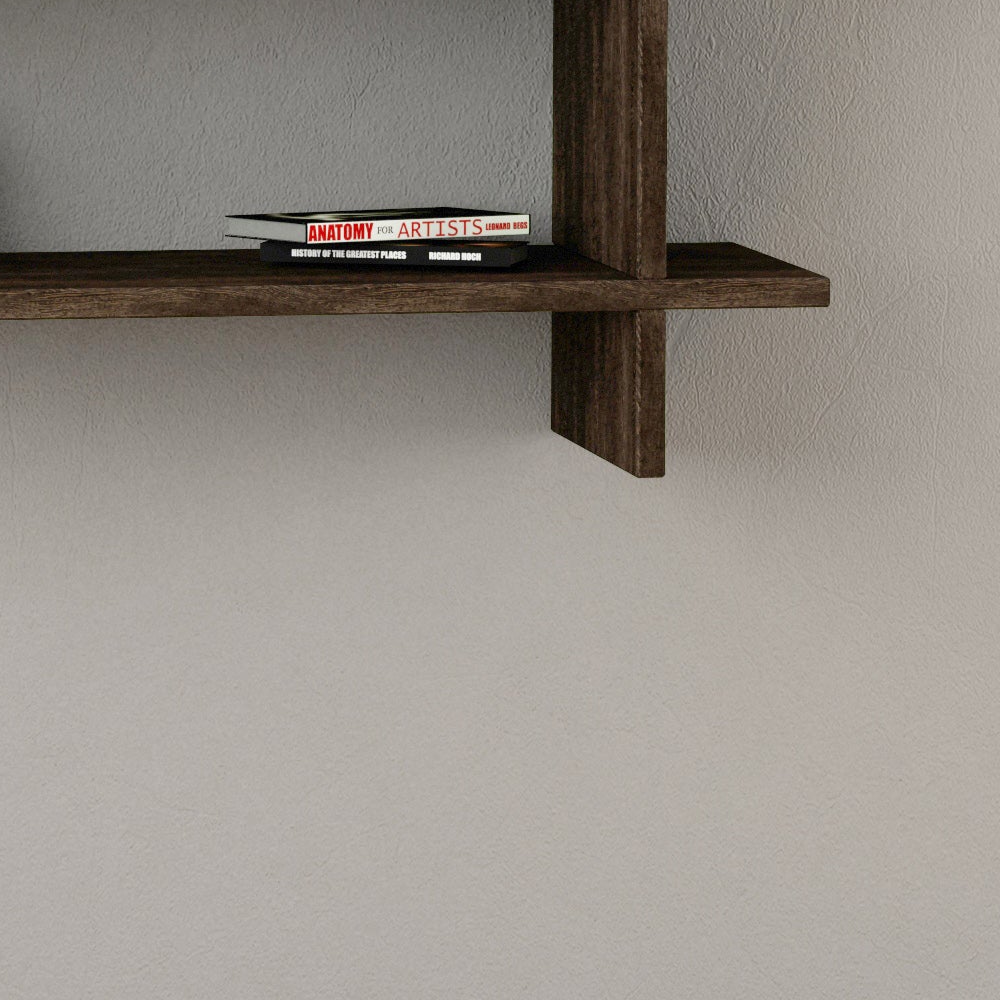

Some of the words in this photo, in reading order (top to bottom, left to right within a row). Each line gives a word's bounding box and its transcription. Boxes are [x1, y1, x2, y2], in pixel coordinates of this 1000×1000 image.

[308, 222, 374, 242] ANATOMY
[377, 226, 393, 235] FOR
[397, 219, 483, 239] ARTISTS
[485, 222, 511, 231] LEONARD
[291, 248, 322, 258] HISTORY
[322, 249, 332, 258] OF
[332, 250, 345, 258] THE
[346, 250, 380, 259] GREATEST
[380, 251, 407, 260] PLACES
[428, 251, 461, 261] RICHARD
